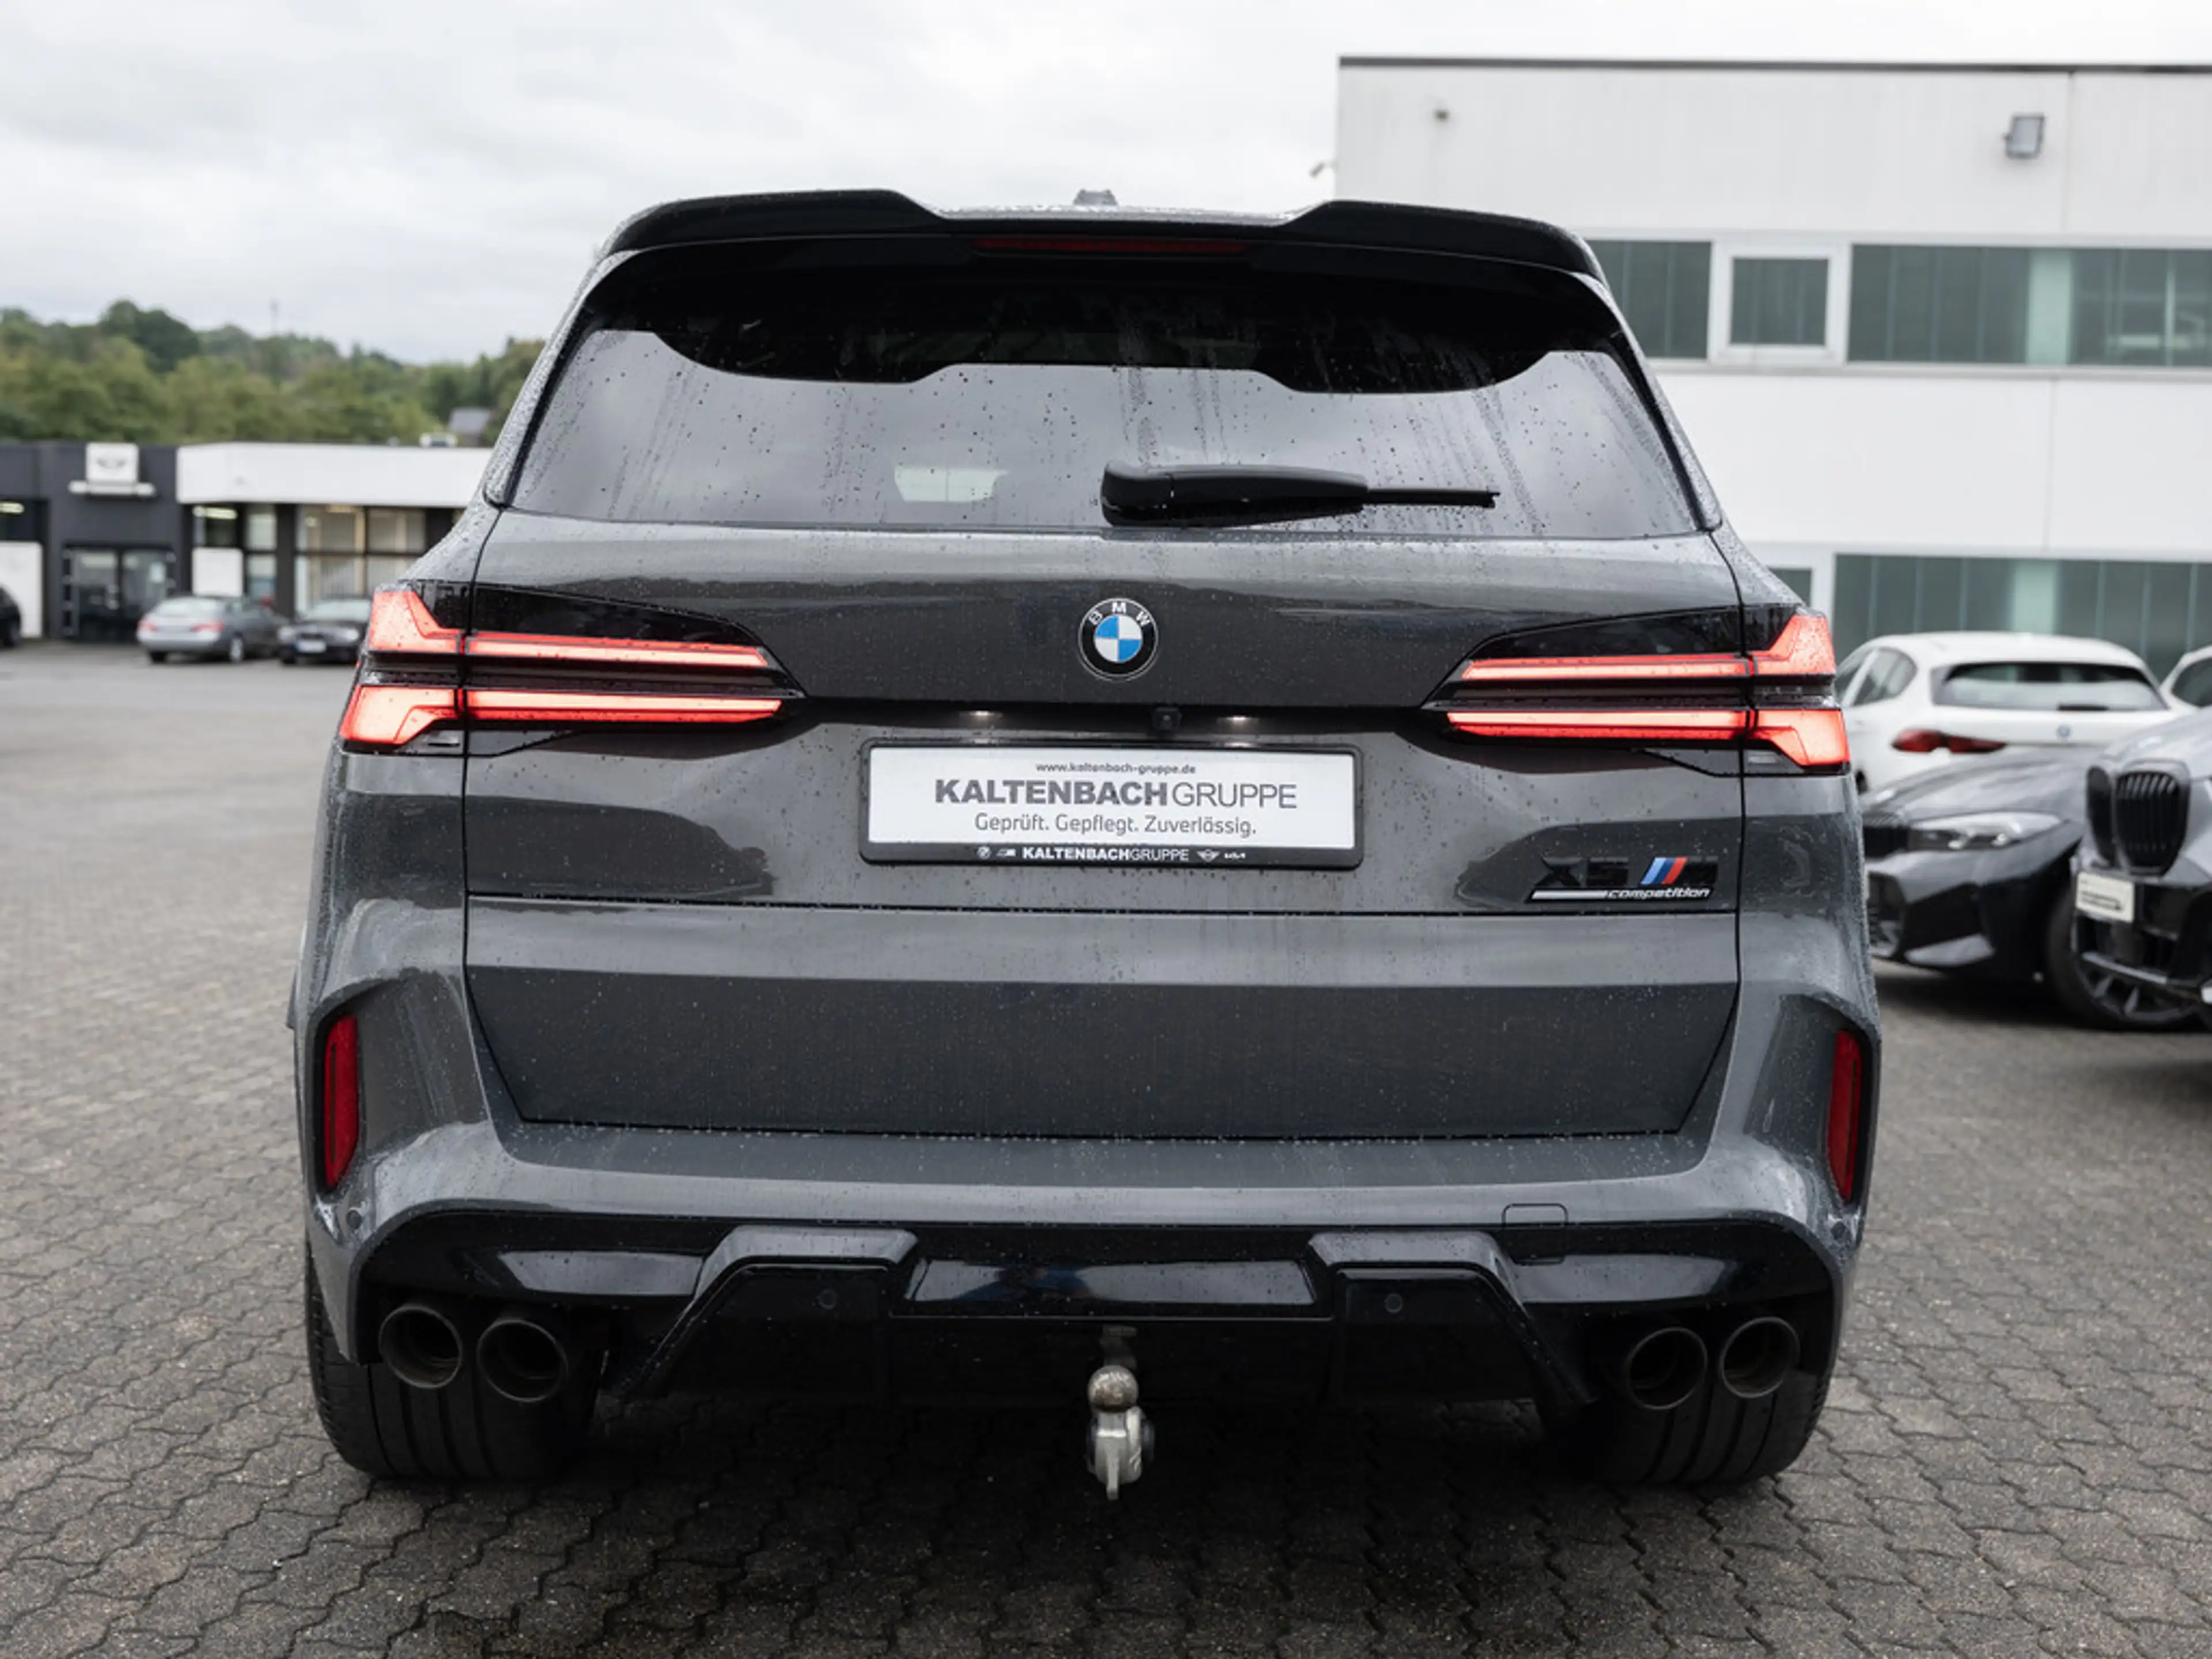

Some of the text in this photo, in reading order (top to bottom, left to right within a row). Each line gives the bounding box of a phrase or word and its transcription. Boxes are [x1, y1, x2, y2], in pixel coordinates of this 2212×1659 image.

[1088, 602, 1150, 626] BMW
[1036, 762, 1196, 775] www.kaltenbach-gruppe.de
[975, 812, 1256, 839] Geprüft. Gepflegt. Zuverlässig.
[1606, 887, 1710, 900] competition
